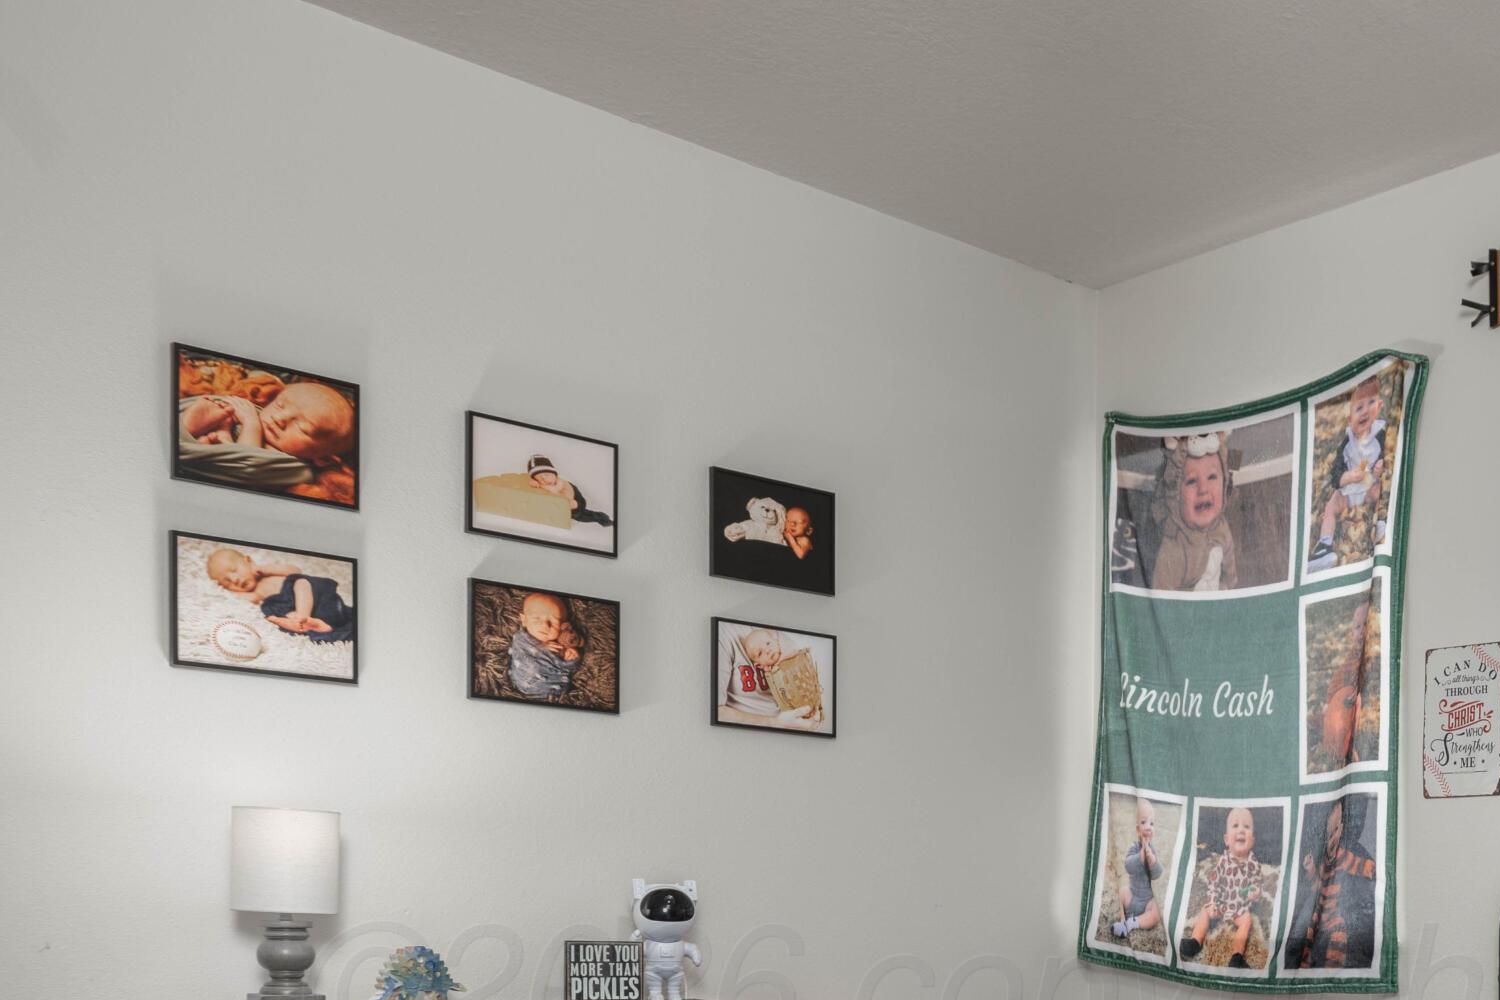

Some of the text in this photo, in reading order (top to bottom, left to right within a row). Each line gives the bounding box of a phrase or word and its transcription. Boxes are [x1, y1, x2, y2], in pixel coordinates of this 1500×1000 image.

[1433, 659, 1498, 687] I CAN DO
[1213, 674, 1275, 719] Cash
[1444, 684, 1488, 697] THROUGH
[1447, 702, 1484, 729] CHRIST
[1465, 726, 1484, 738] WHO
[1430, 732, 1496, 767] Strengthens
[1460, 756, 1476, 769] ME
[570, 944, 639, 963] I LOVE YOU
[570, 962, 640, 977] MORE THAN
[571, 976, 640, 1000] PICKLES
